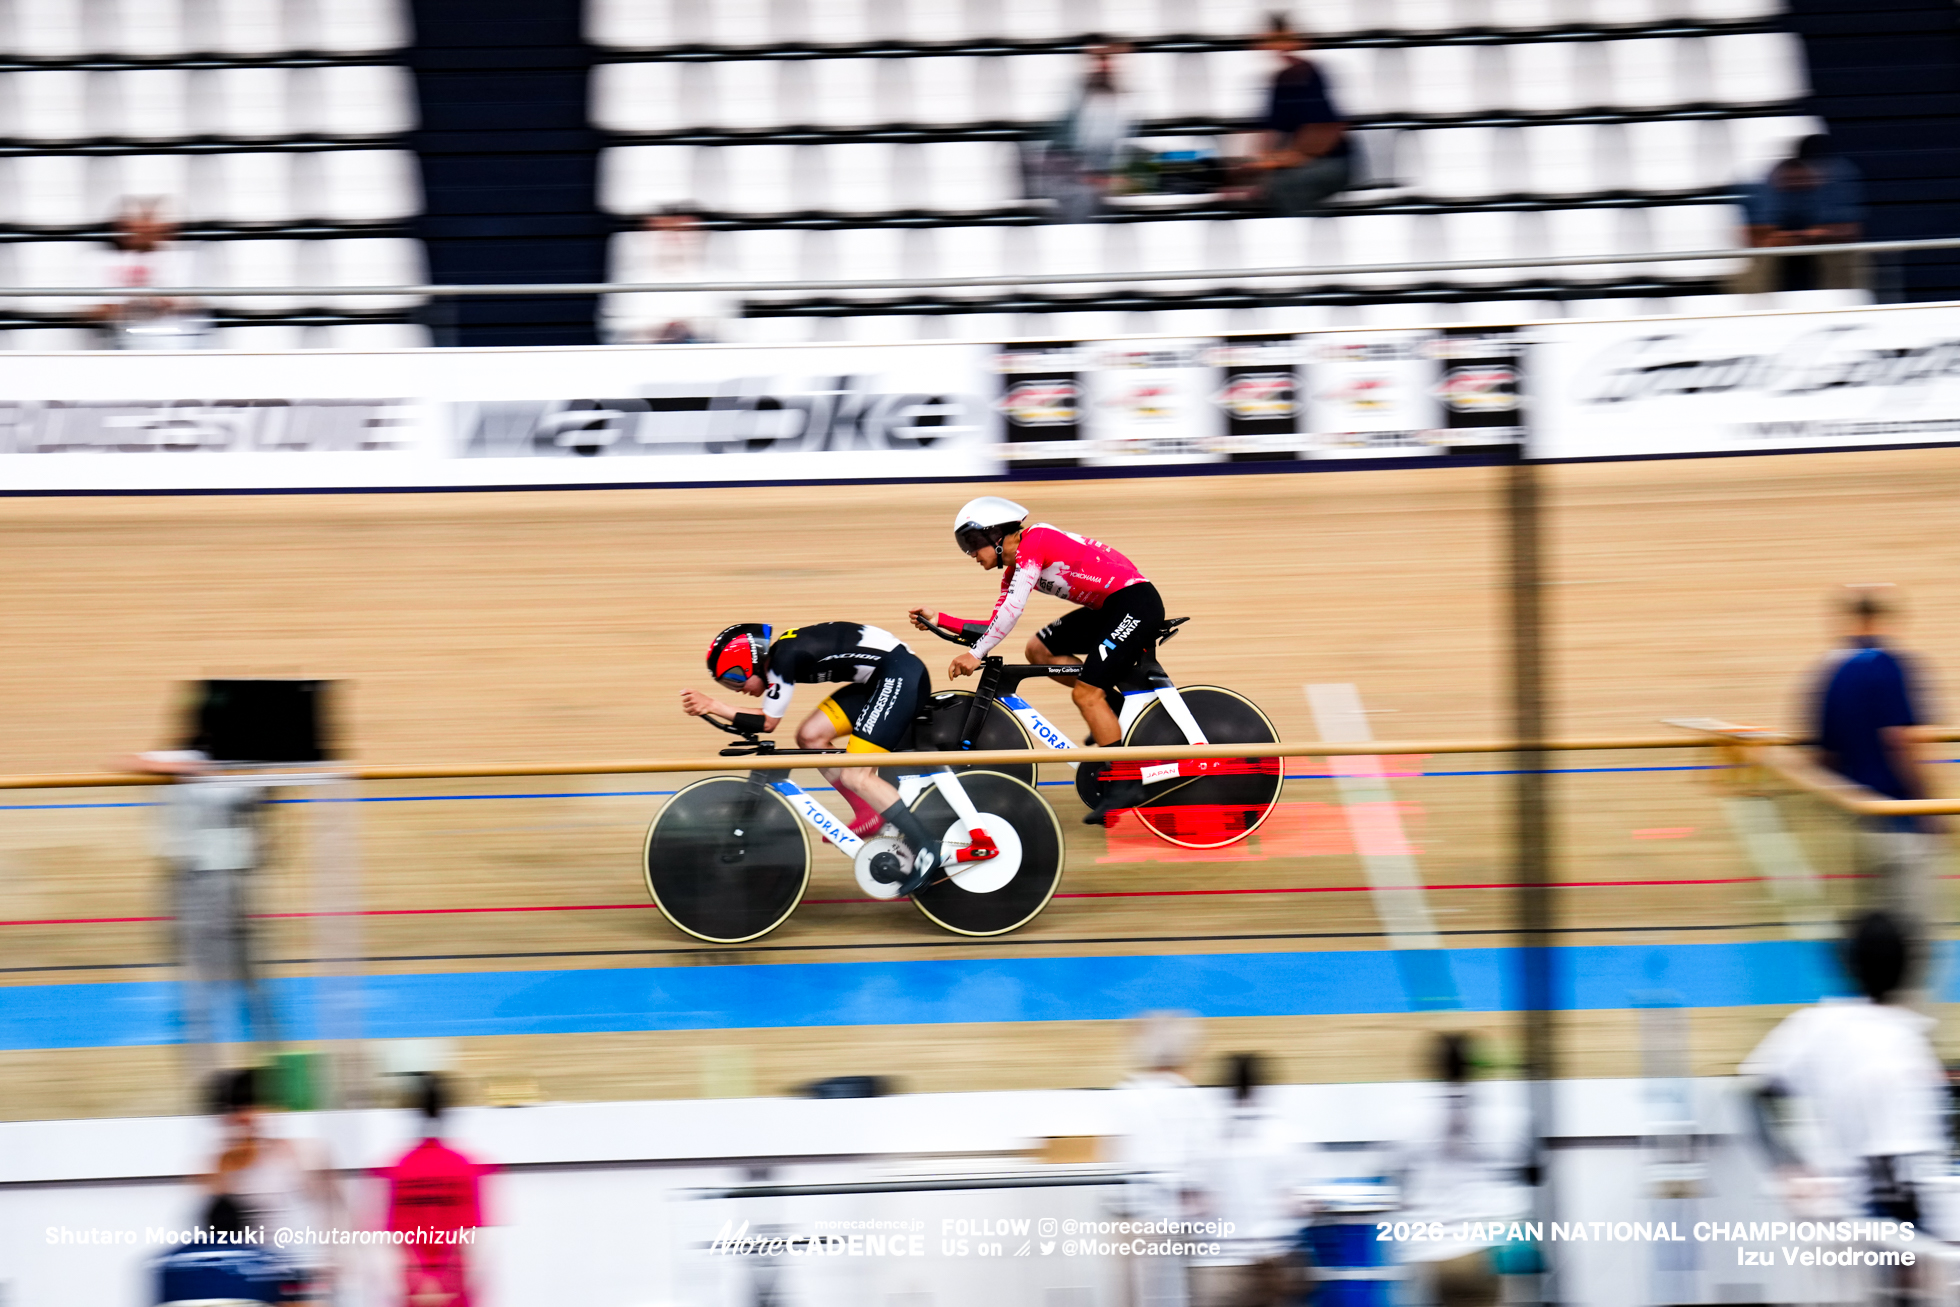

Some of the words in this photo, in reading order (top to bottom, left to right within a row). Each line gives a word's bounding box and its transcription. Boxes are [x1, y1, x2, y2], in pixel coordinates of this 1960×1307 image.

[1070, 571, 1102, 584] YOKOHAMA
[1110, 613, 1134, 640] ANEST
[1117, 619, 1142, 642] IWATA
[817, 652, 882, 663] ANCHOR
[862, 677, 895, 736] BRIDGESTONE
[1031, 715, 1071, 749] 'TORA
[1146, 768, 1176, 779] JAPAN
